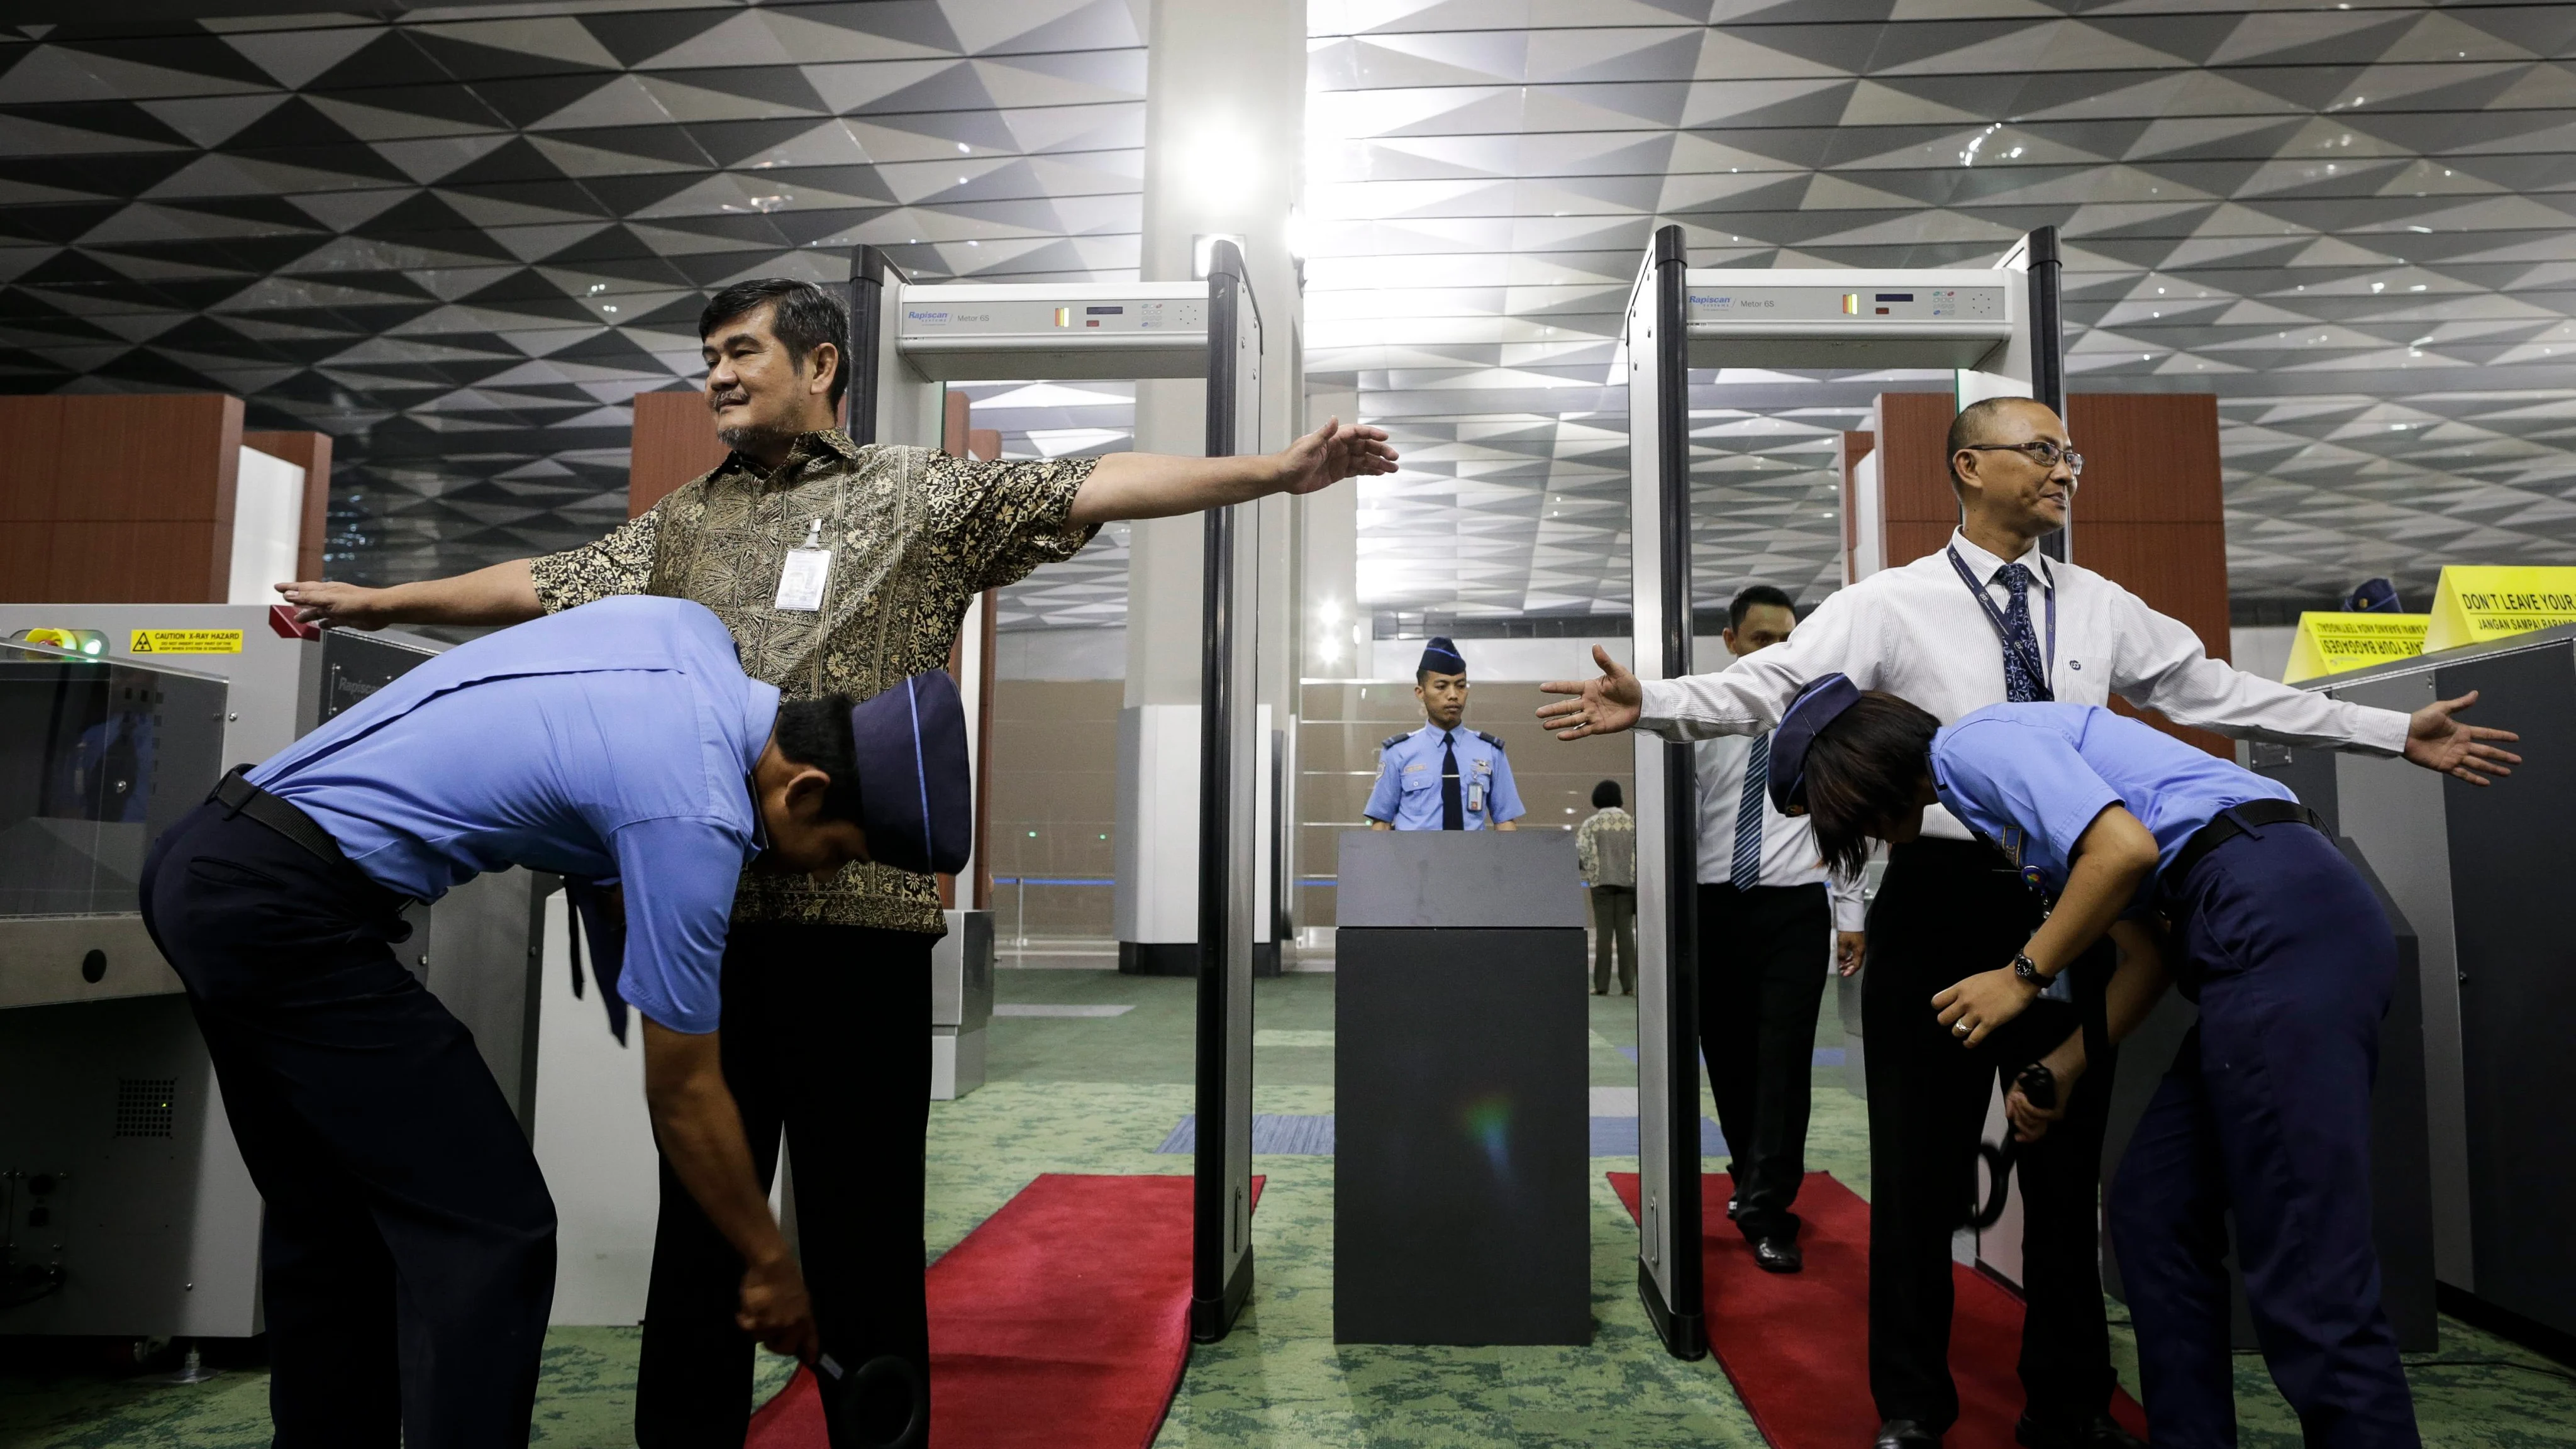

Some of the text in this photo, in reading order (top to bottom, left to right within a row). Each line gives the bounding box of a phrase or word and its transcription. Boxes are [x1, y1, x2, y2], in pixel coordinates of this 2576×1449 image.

[1689, 295, 1730, 304] Rapiscan
[908, 311, 948, 320] Rapiscan
[2462, 594, 2576, 610] DON'T LEAVE YOUR
[2478, 618, 2511, 630] JANGAN
[2510, 619, 2540, 630] SAMPAI
[2319, 640, 2377, 655] BAGGAGES!
[2379, 640, 2404, 655] YOUR
